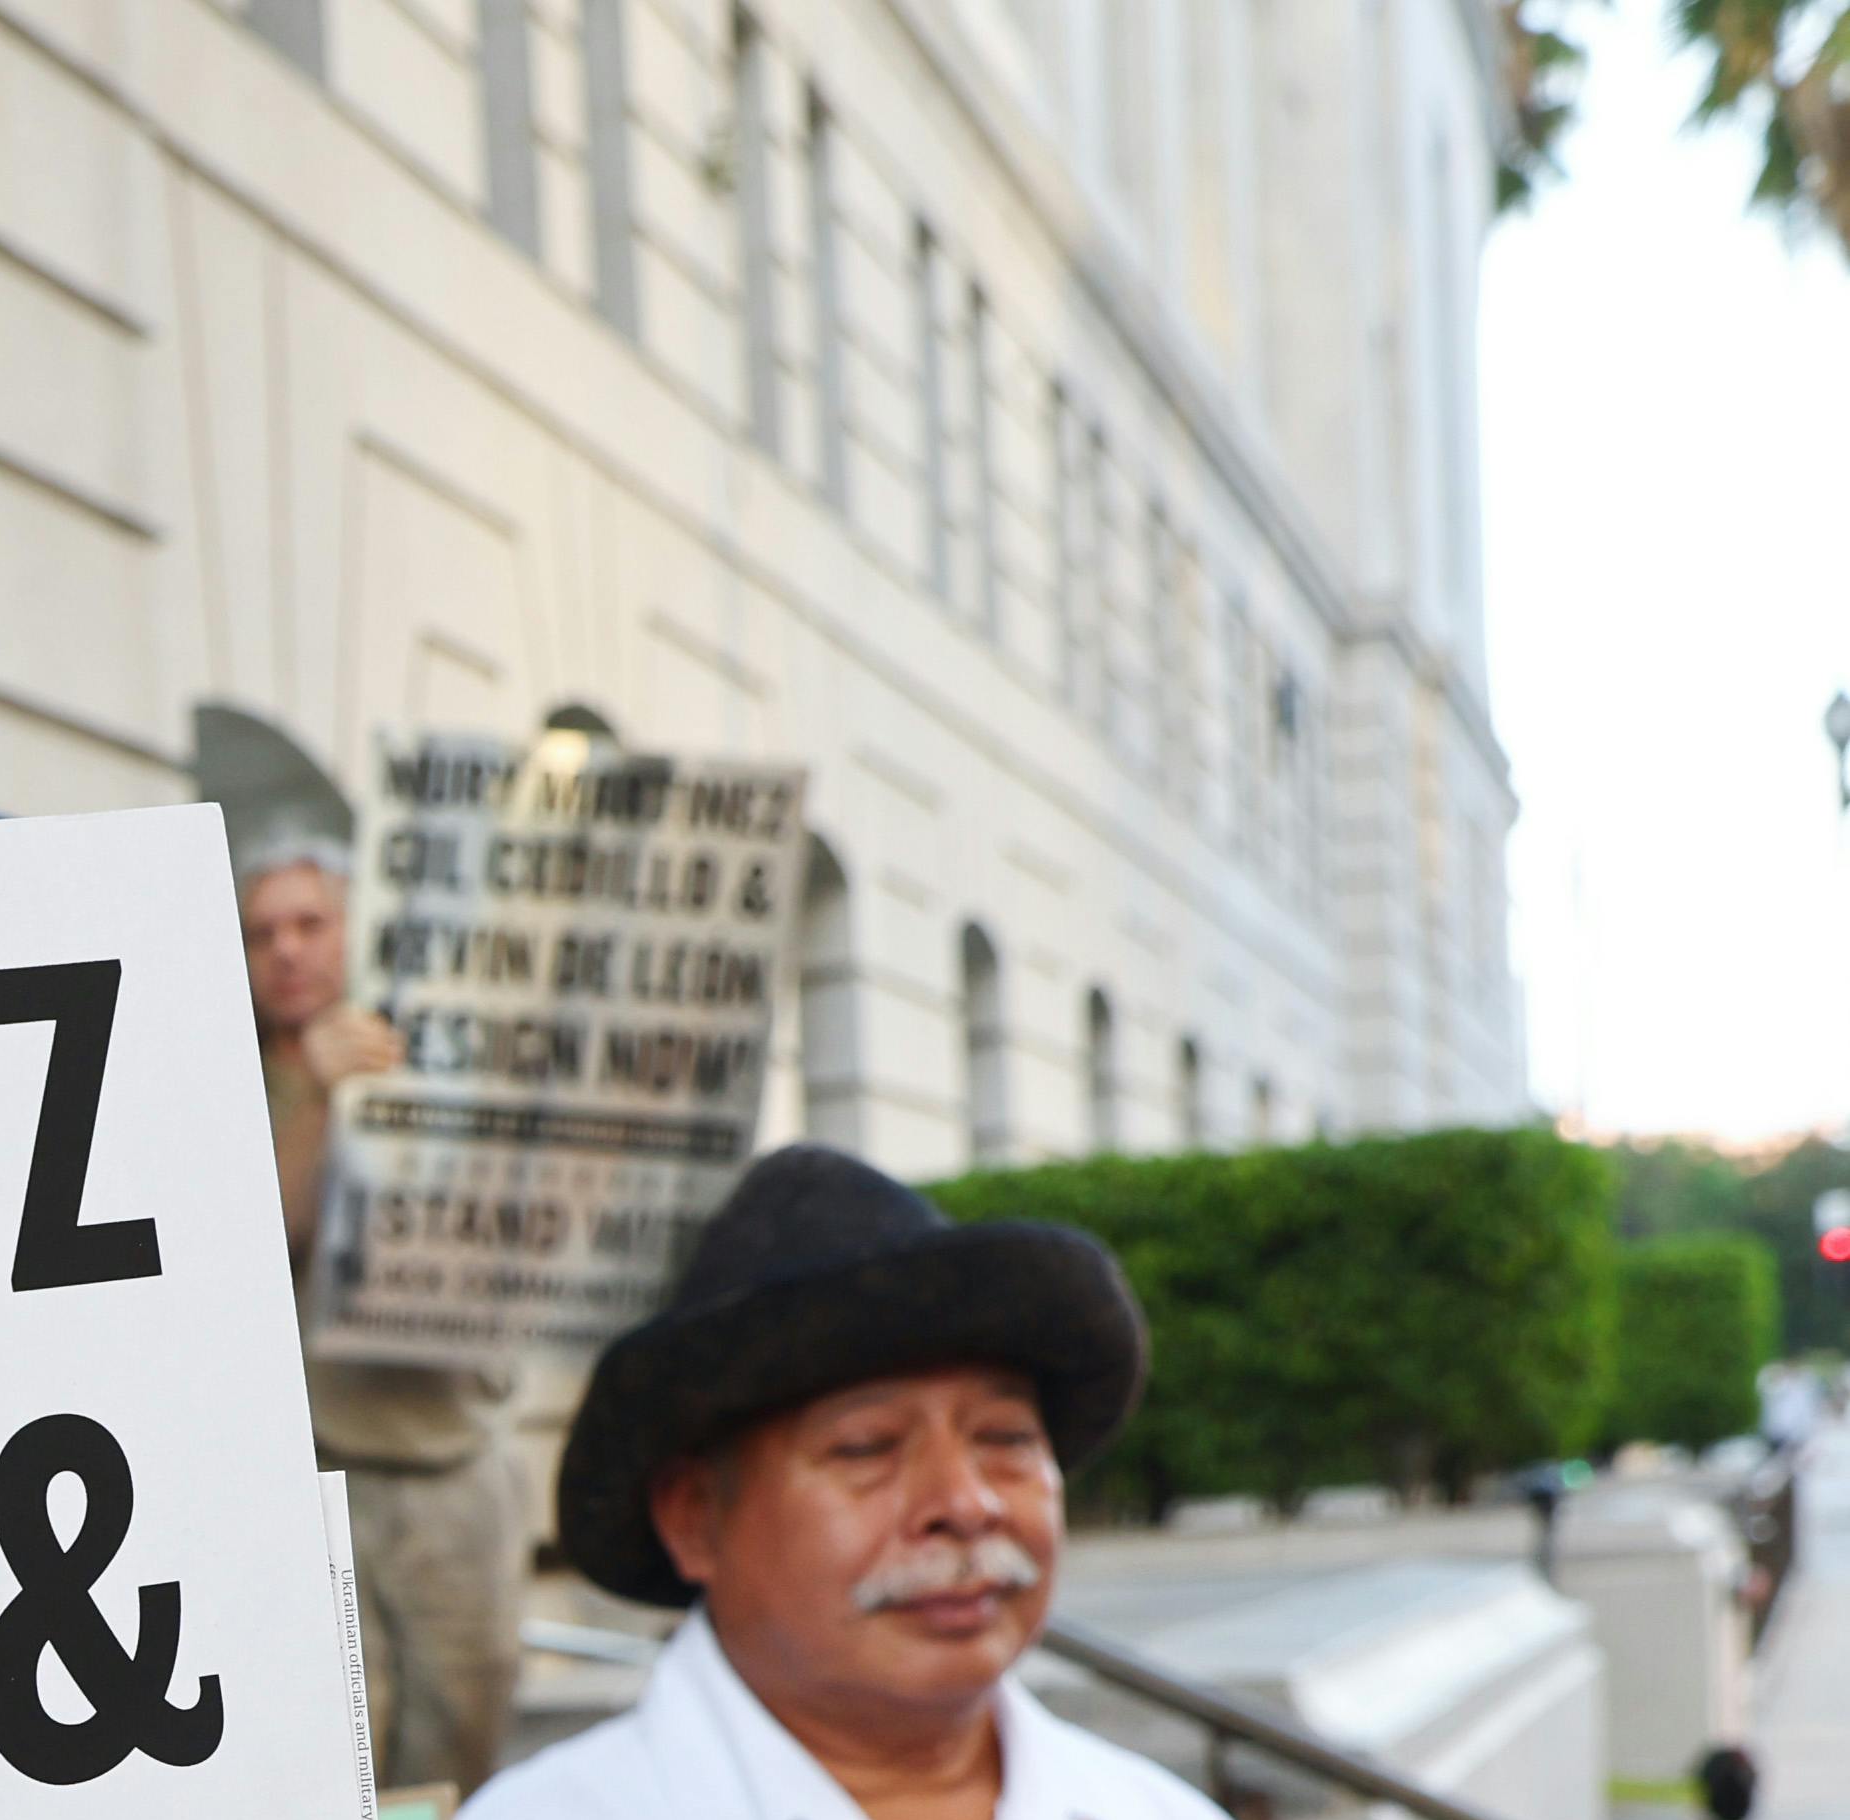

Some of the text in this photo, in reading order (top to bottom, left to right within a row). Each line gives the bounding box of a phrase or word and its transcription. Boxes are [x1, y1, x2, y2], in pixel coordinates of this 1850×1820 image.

[341, 1569, 373, 1820] Ukrainian officials and military
